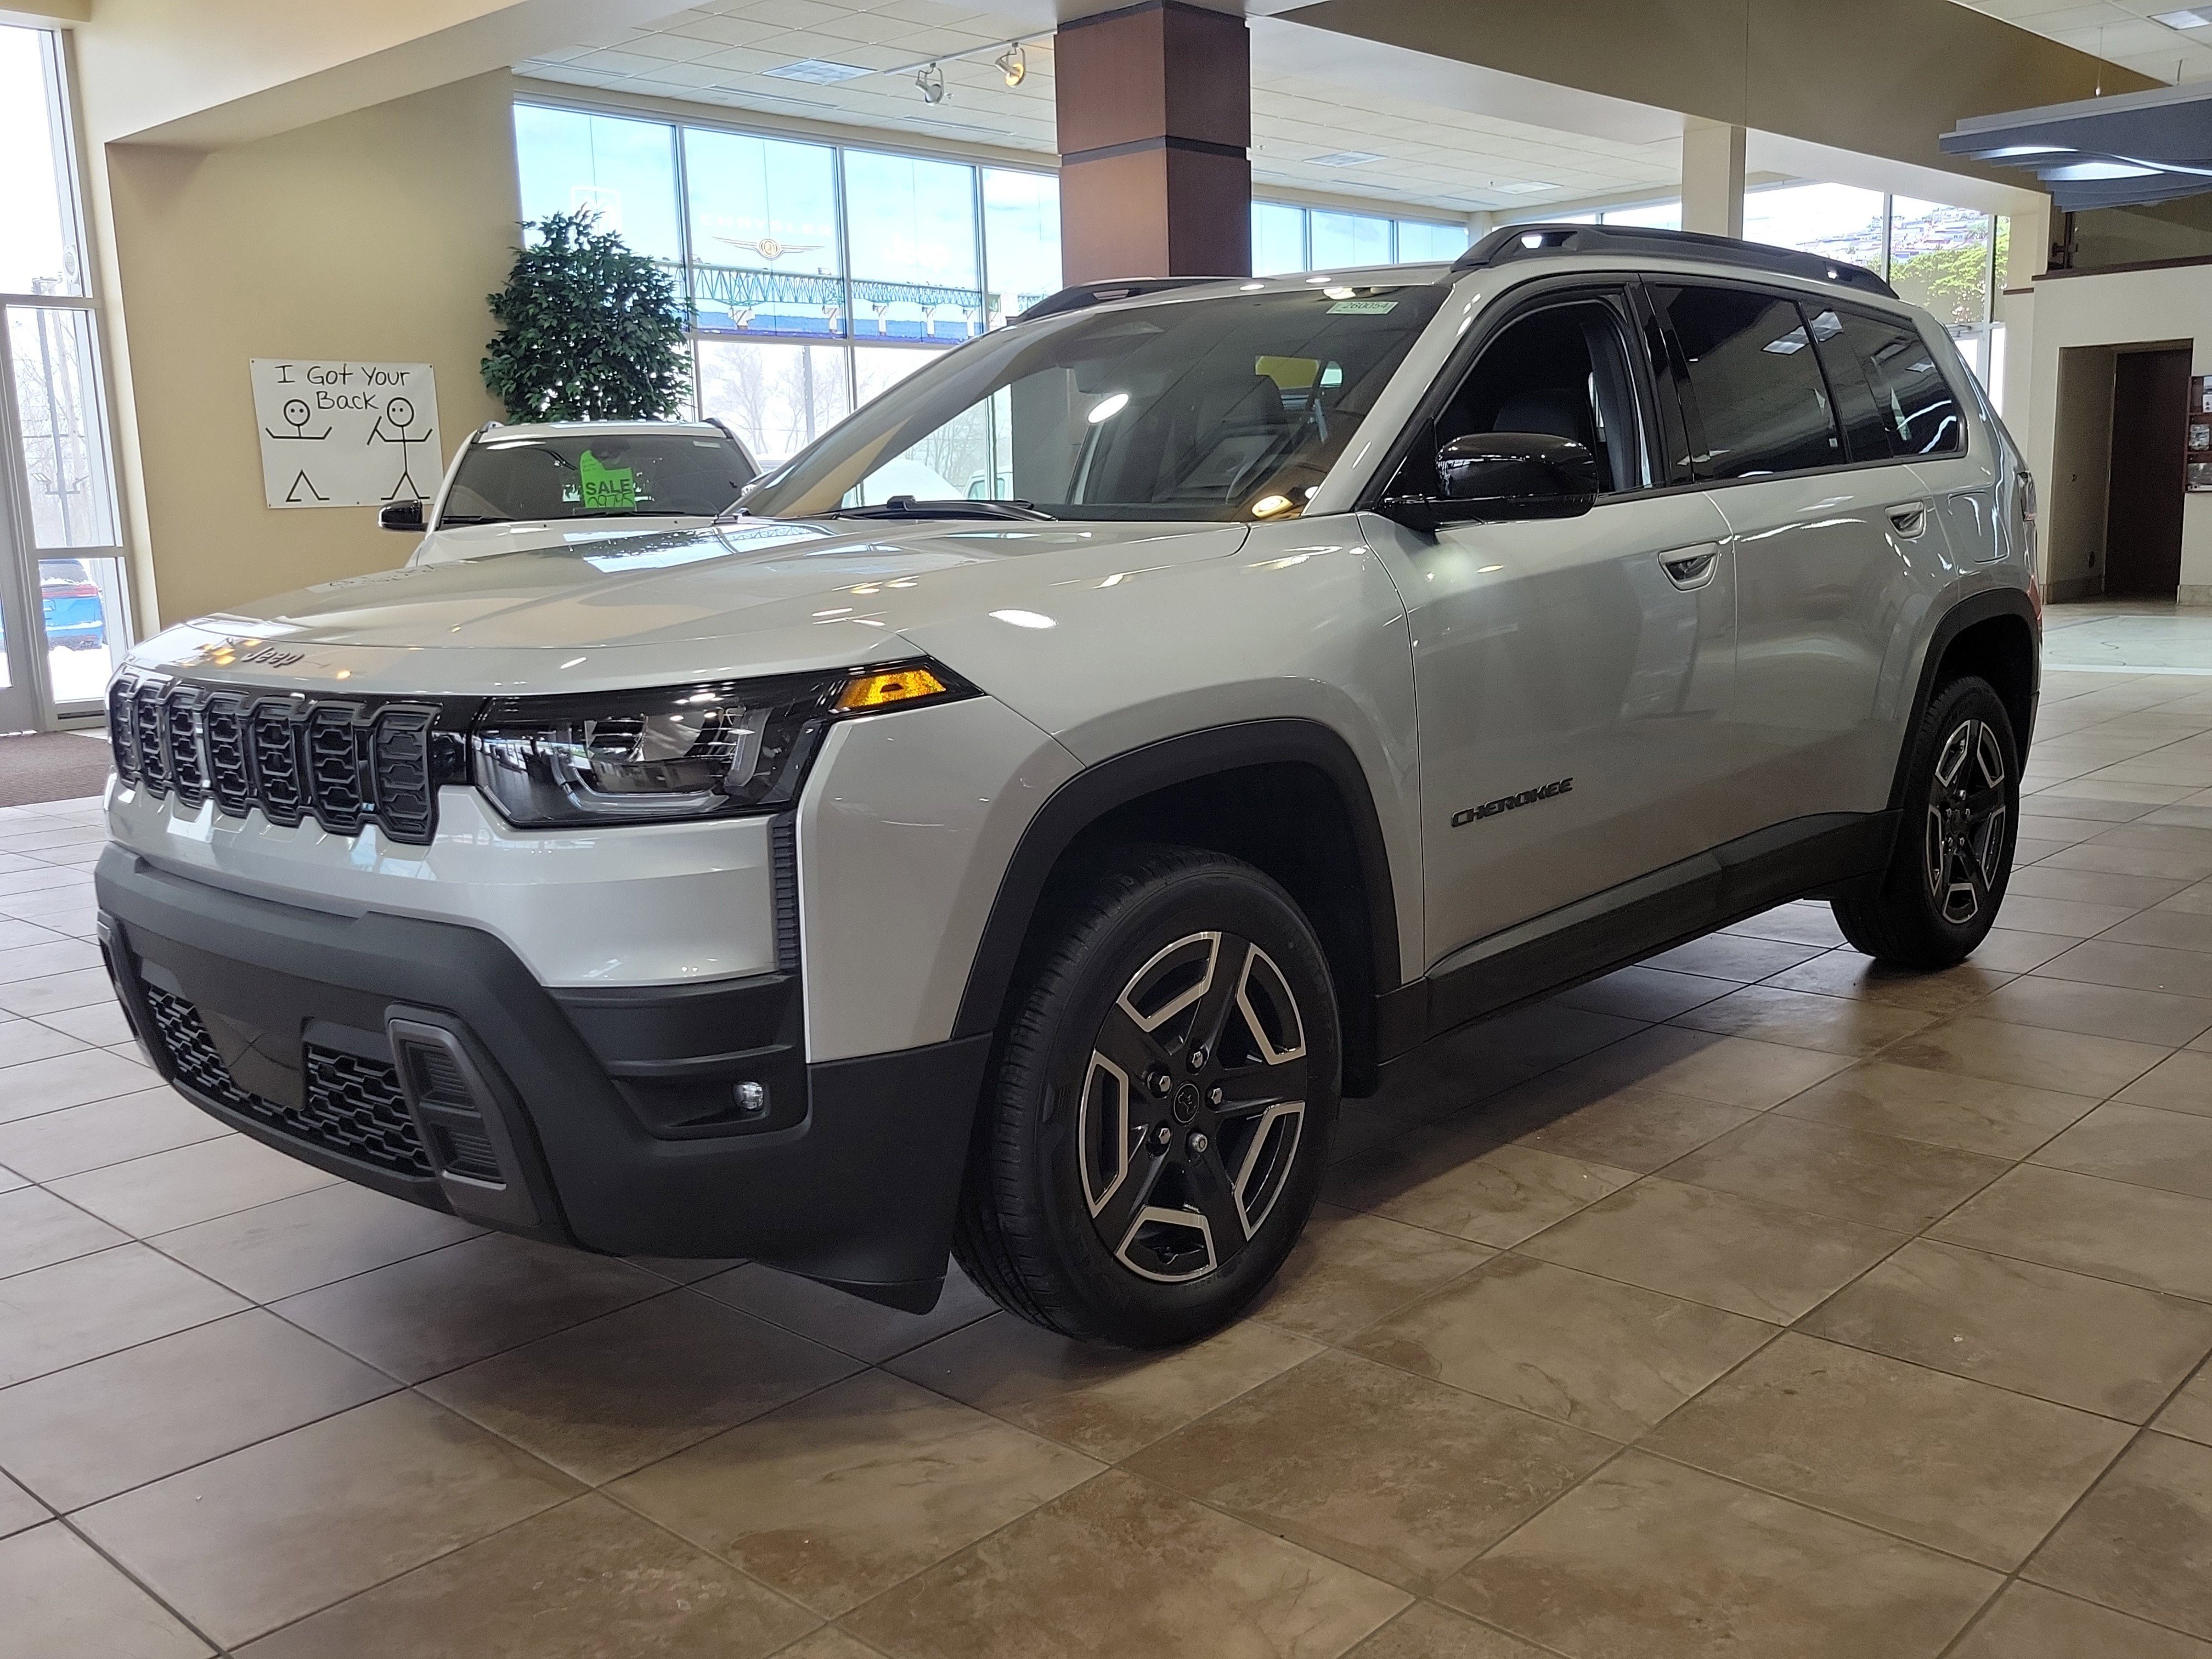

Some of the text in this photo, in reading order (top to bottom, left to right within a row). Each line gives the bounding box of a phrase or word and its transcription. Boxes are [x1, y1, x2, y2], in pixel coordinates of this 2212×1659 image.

[275, 363, 410, 386] I Got Your
[316, 391, 379, 410] Back
[585, 479, 631, 495] SALE
[241, 647, 304, 668] Jeep
[1451, 777, 1573, 827] CHEROKEE
